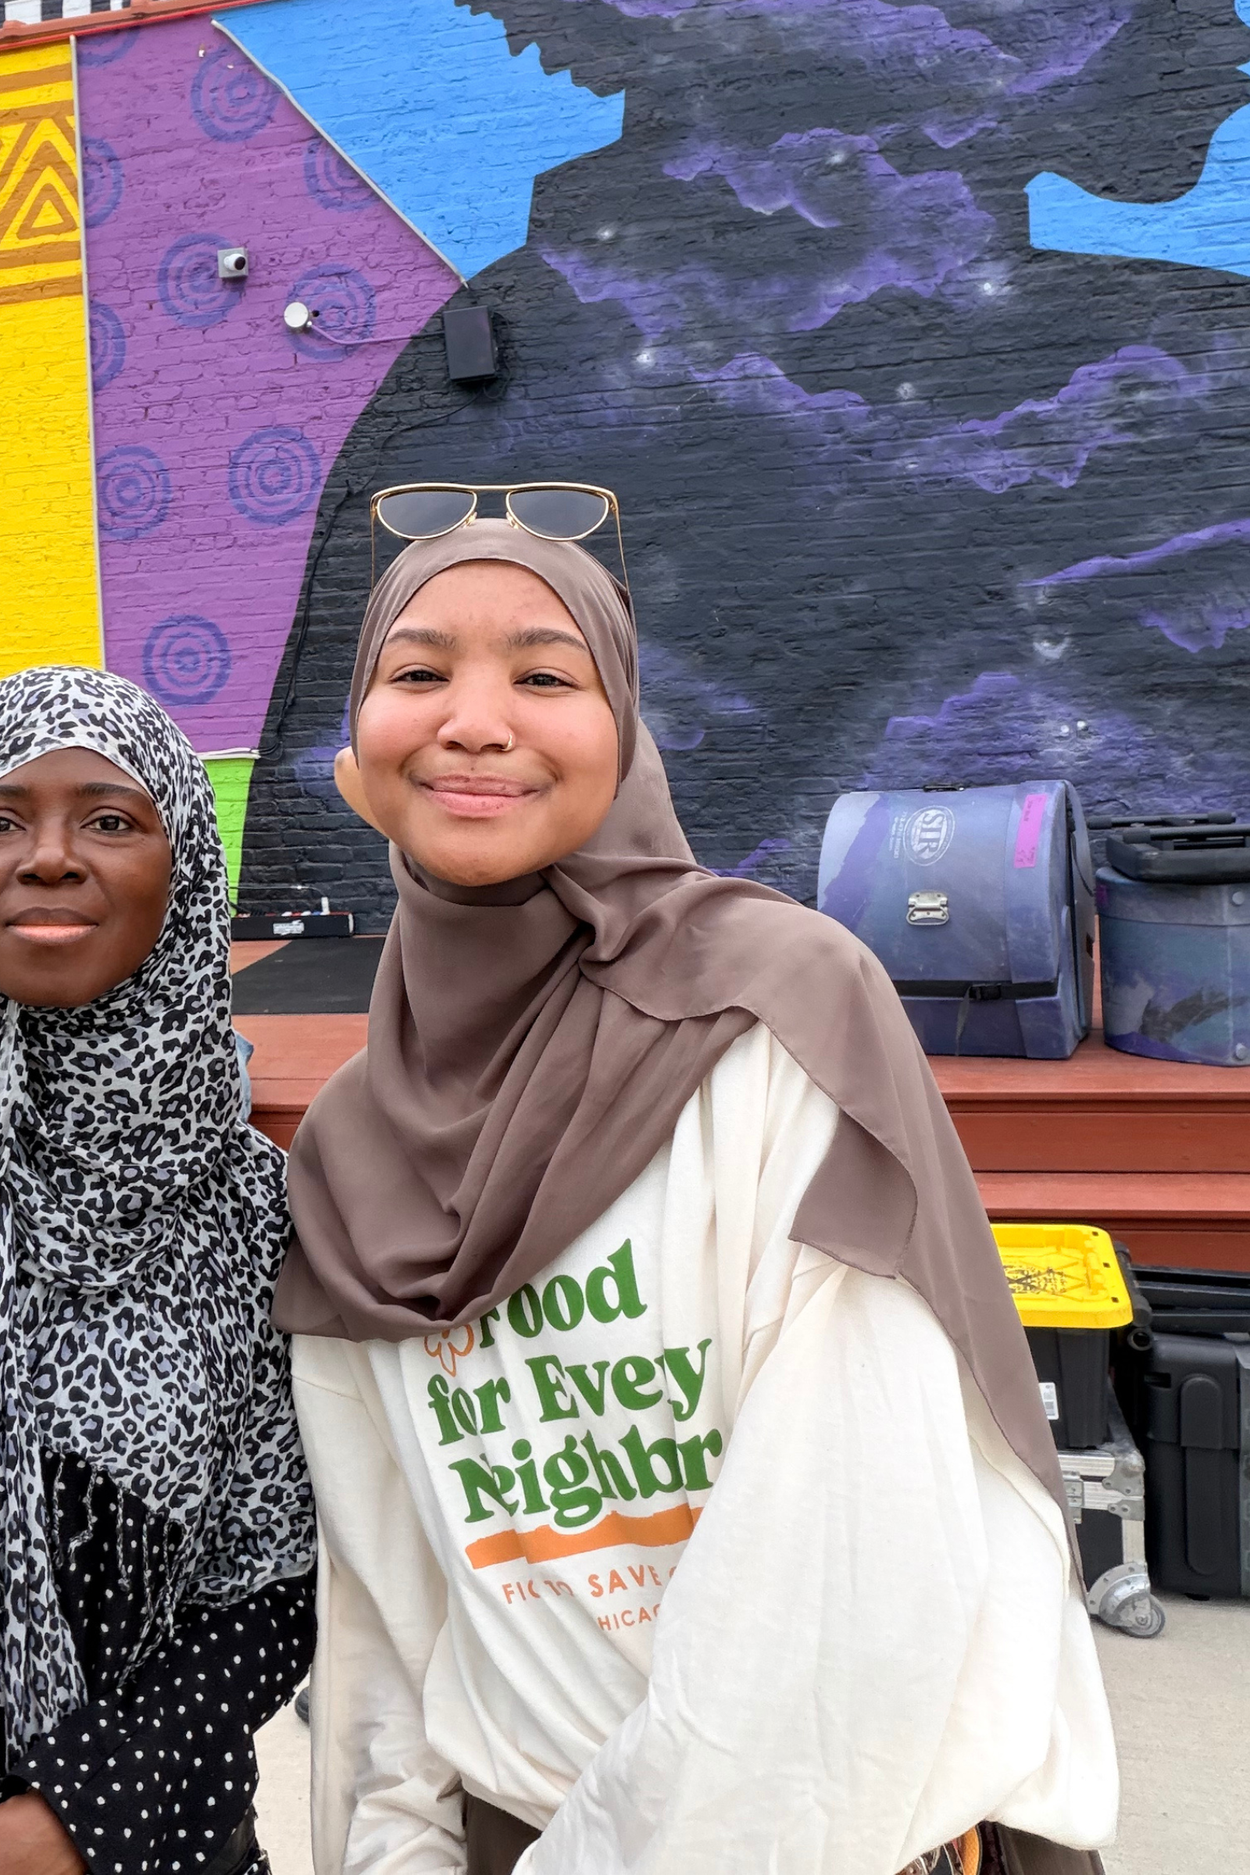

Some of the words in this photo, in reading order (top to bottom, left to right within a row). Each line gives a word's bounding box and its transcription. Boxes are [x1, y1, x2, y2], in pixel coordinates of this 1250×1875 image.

[916, 811, 947, 859] SIR
[427, 1374, 511, 1446] for
[587, 1564, 662, 1598] SAVE
